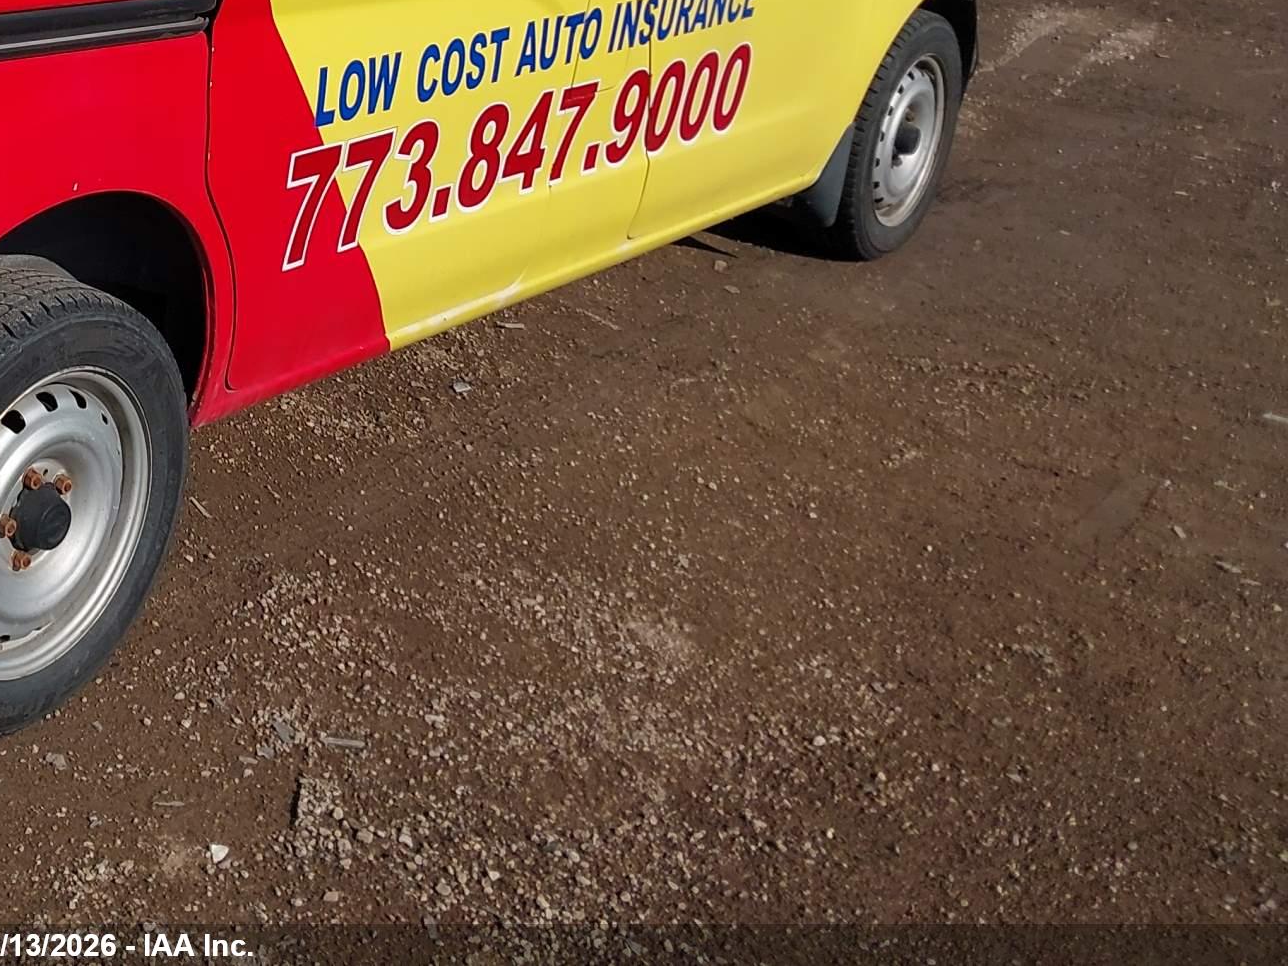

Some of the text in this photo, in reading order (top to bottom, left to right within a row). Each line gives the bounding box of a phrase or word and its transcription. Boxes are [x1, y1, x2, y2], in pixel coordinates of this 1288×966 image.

[314, 51, 402, 128] LOW
[416, 26, 511, 103] COST
[514, 7, 603, 77] AUTO
[282, 42, 753, 272] 773.847.9000
